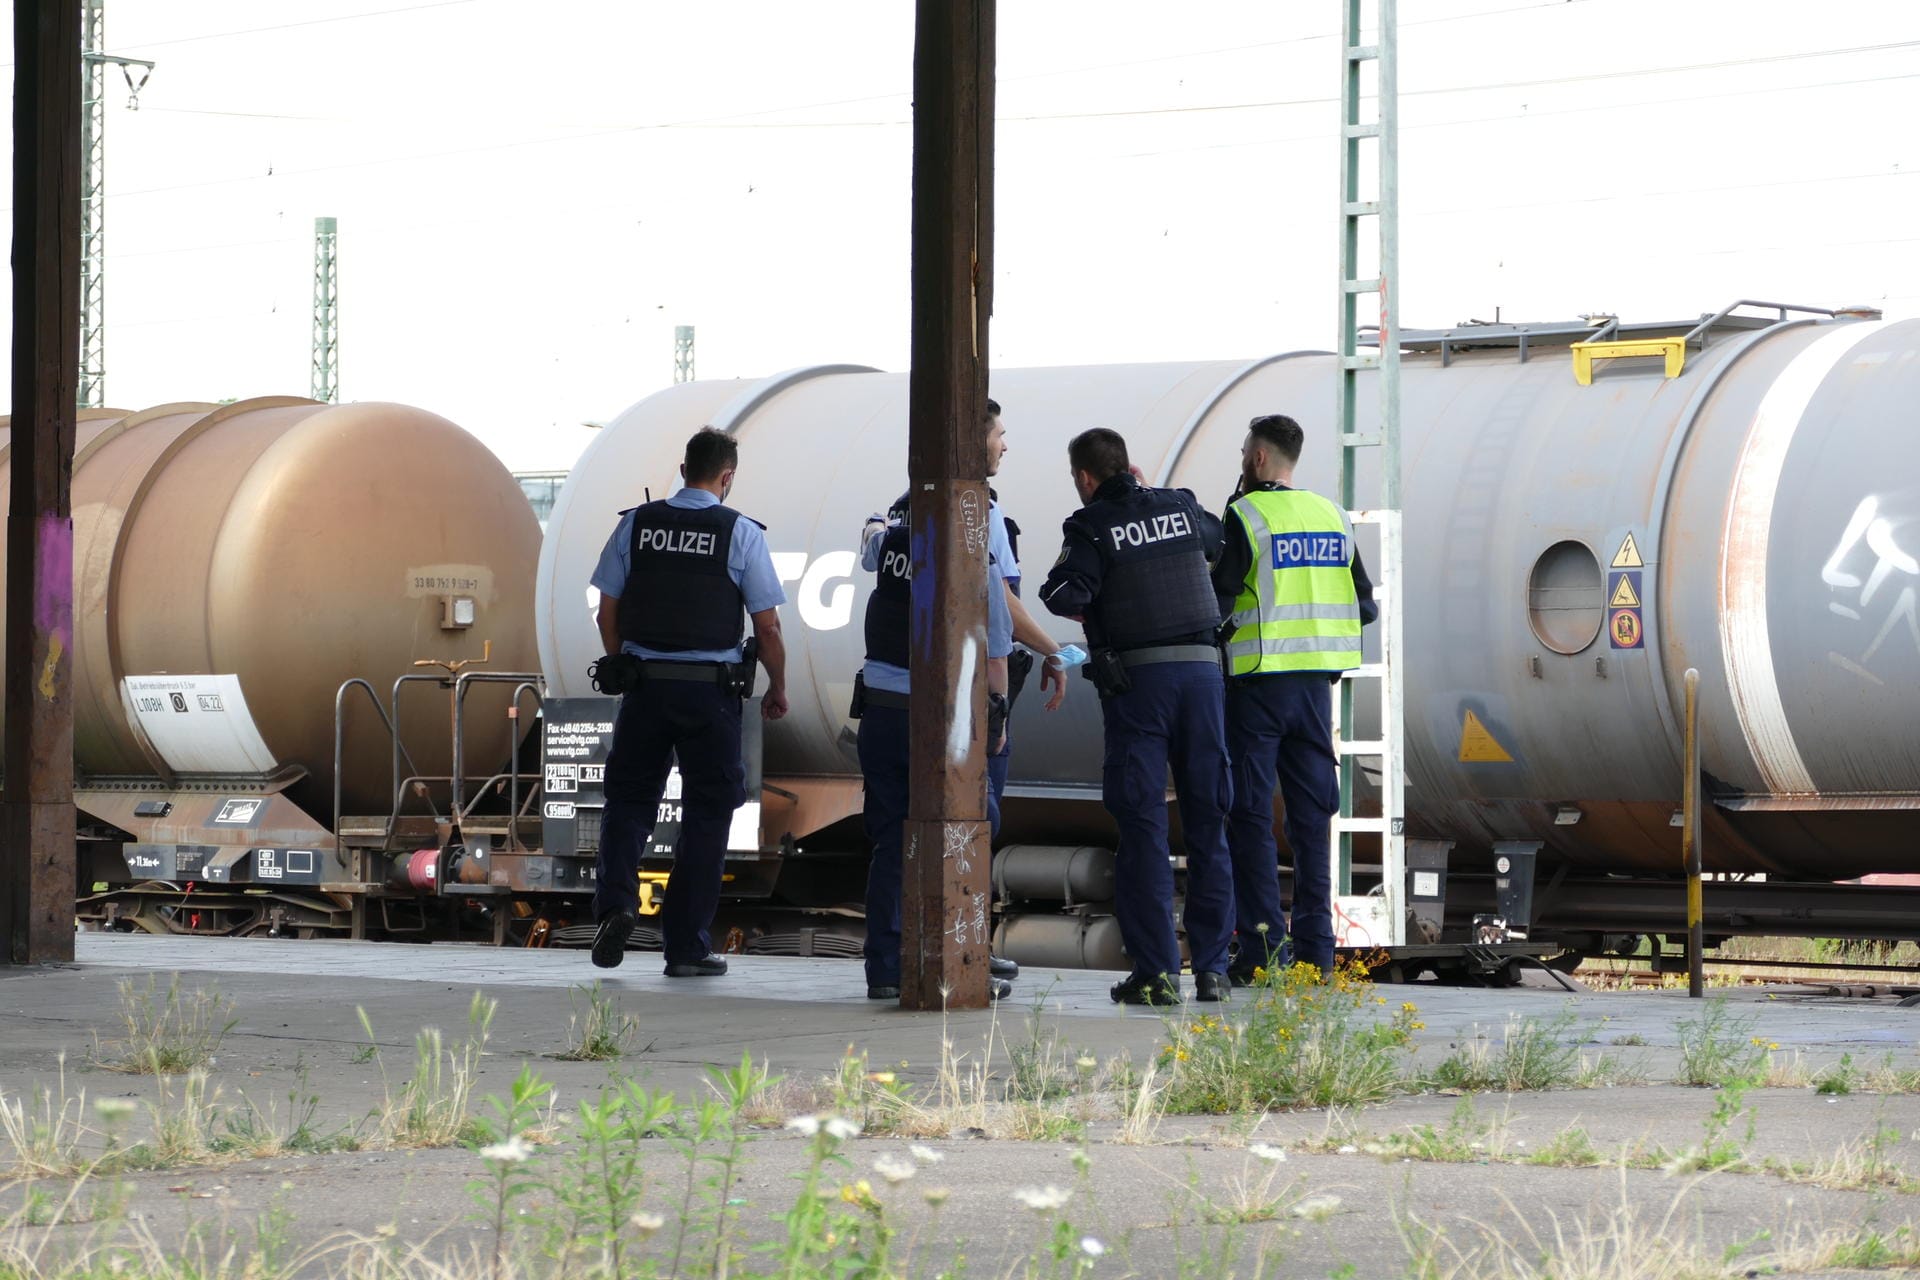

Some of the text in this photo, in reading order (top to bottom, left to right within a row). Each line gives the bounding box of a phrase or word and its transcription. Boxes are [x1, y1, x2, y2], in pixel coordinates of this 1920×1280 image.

[1111, 512, 1192, 551] POLIZEI
[638, 528, 717, 556] POLIZEI
[1277, 538, 1347, 563] POLIZEI
[135, 696, 164, 712] L10BH
[547, 723, 560, 734] Fax
[547, 734, 600, 747] service@vtg.com
[547, 746, 590, 758] www.vtg.com
[656, 803, 683, 822] 73-0
[654, 844, 664, 853] JET
